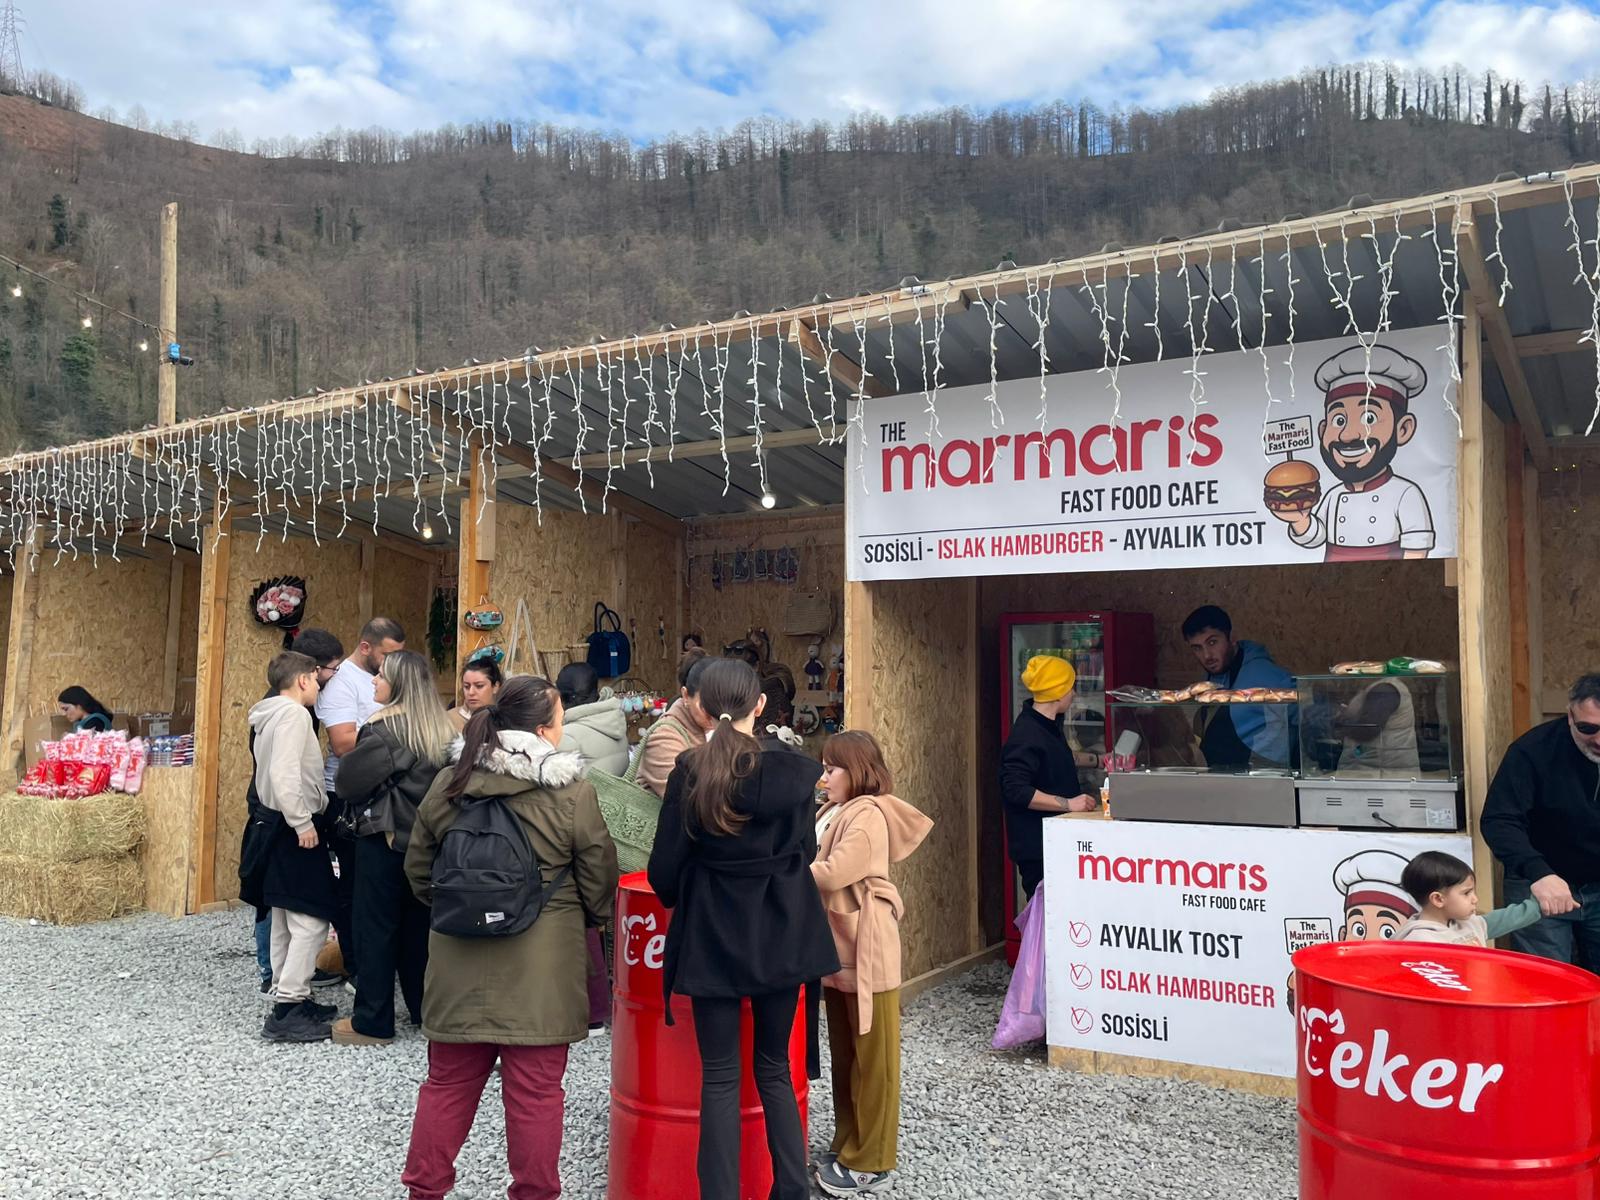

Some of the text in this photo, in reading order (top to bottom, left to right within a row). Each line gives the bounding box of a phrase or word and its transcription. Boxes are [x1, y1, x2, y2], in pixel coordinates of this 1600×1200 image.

[880, 422, 906, 443] THE
[1268, 428, 1309, 442] Marmaris
[1279, 422, 1296, 432] The
[882, 413, 1224, 493] marmaris
[1269, 436, 1310, 451] Fast Food
[1061, 480, 1219, 514] FAST FOOD CAFE
[864, 537, 923, 563] SOSİSLİ
[938, 536, 986, 559] ISLAK
[991, 530, 1104, 557] HAMBURGER
[1123, 525, 1206, 550] AYVALIK
[1212, 521, 1266, 546] TOST
[1077, 841, 1093, 852] THE
[1078, 854, 1267, 892] marmaris
[1182, 893, 1266, 912] FAST FOOD CAFE
[1290, 931, 1329, 940] Marmaris
[1300, 921, 1316, 931] The
[1100, 923, 1243, 959] AYVALIK TOST
[1101, 968, 1275, 1008] ISLAK HAMBURGER
[1101, 1013, 1168, 1041] SOSİSLİ
